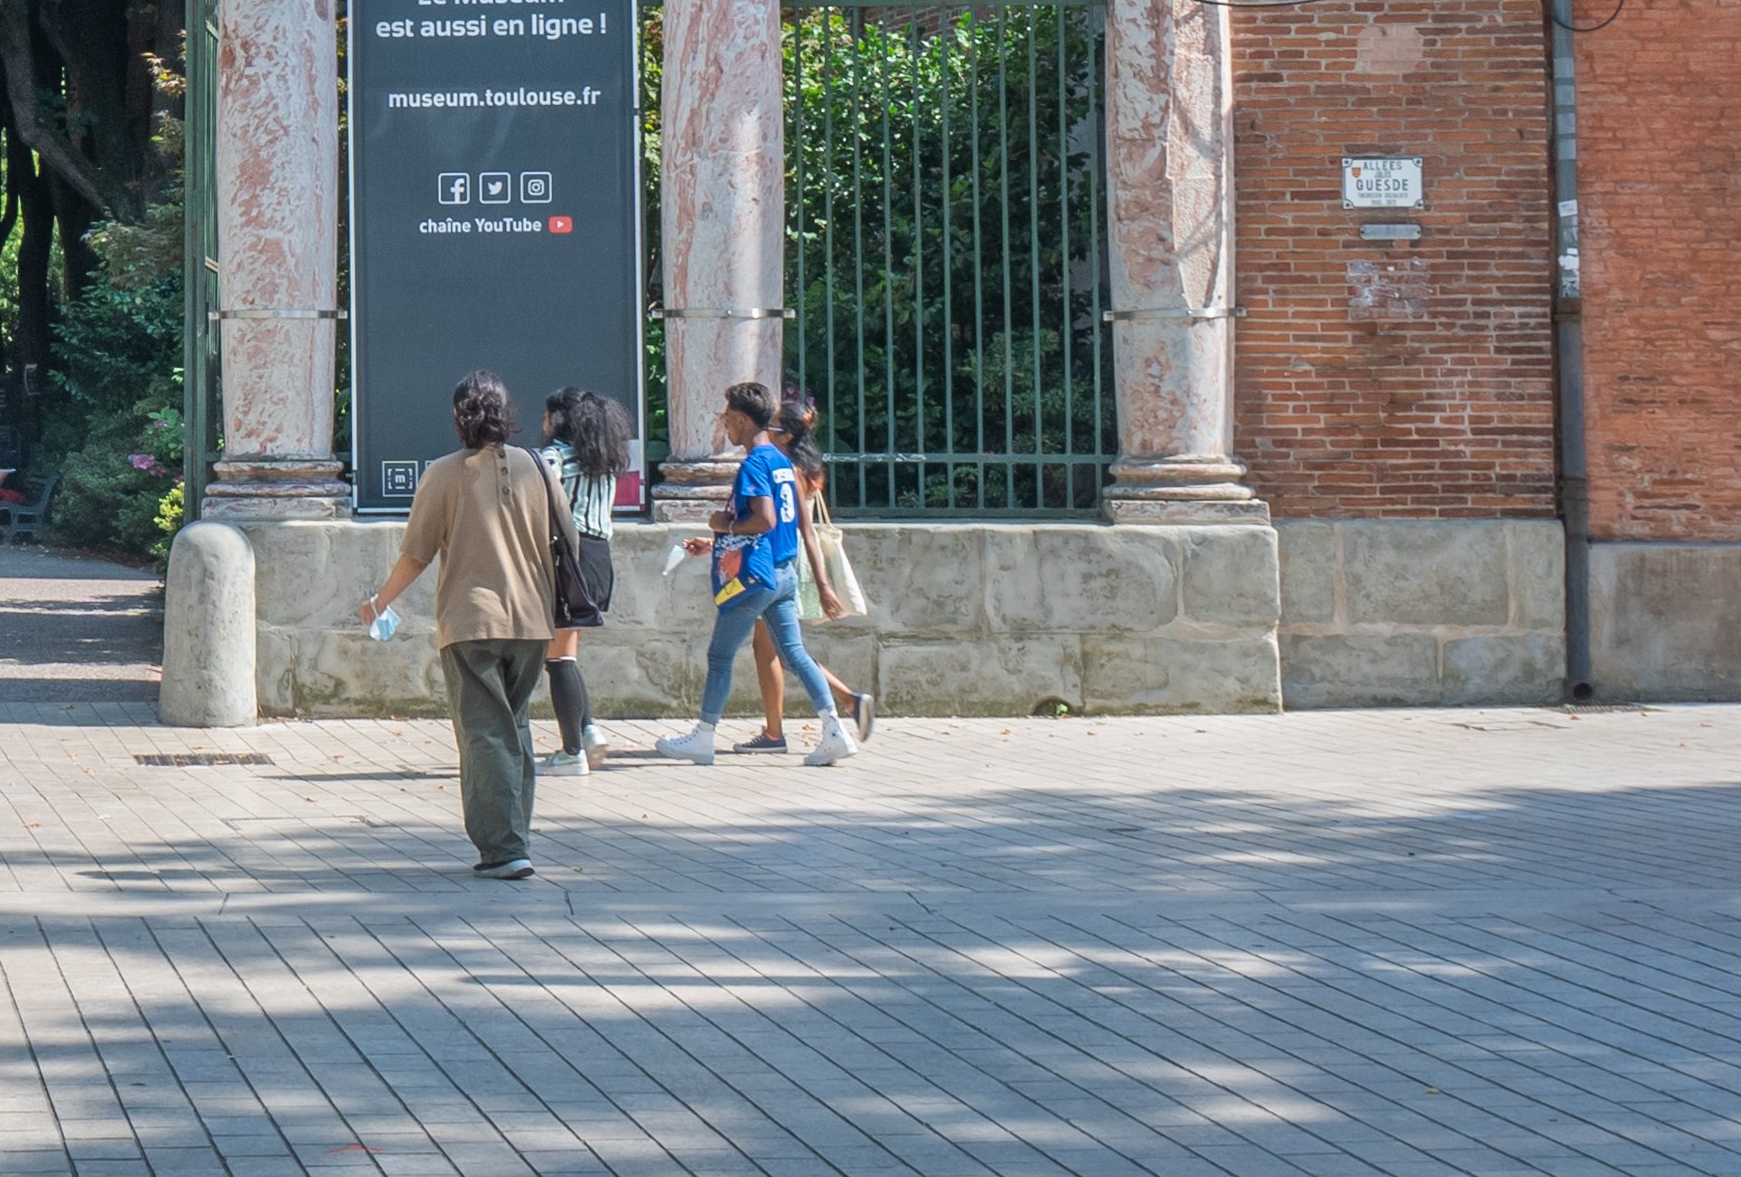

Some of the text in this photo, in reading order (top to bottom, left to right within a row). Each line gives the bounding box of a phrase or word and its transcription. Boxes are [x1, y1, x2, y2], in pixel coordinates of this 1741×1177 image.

[376, 13, 607, 40] est aussi en ligne !
[389, 86, 601, 108] museum.toulouse.fr
[1356, 179, 1409, 191] GUESDE
[419, 217, 542, 233] chaîne YouTube
